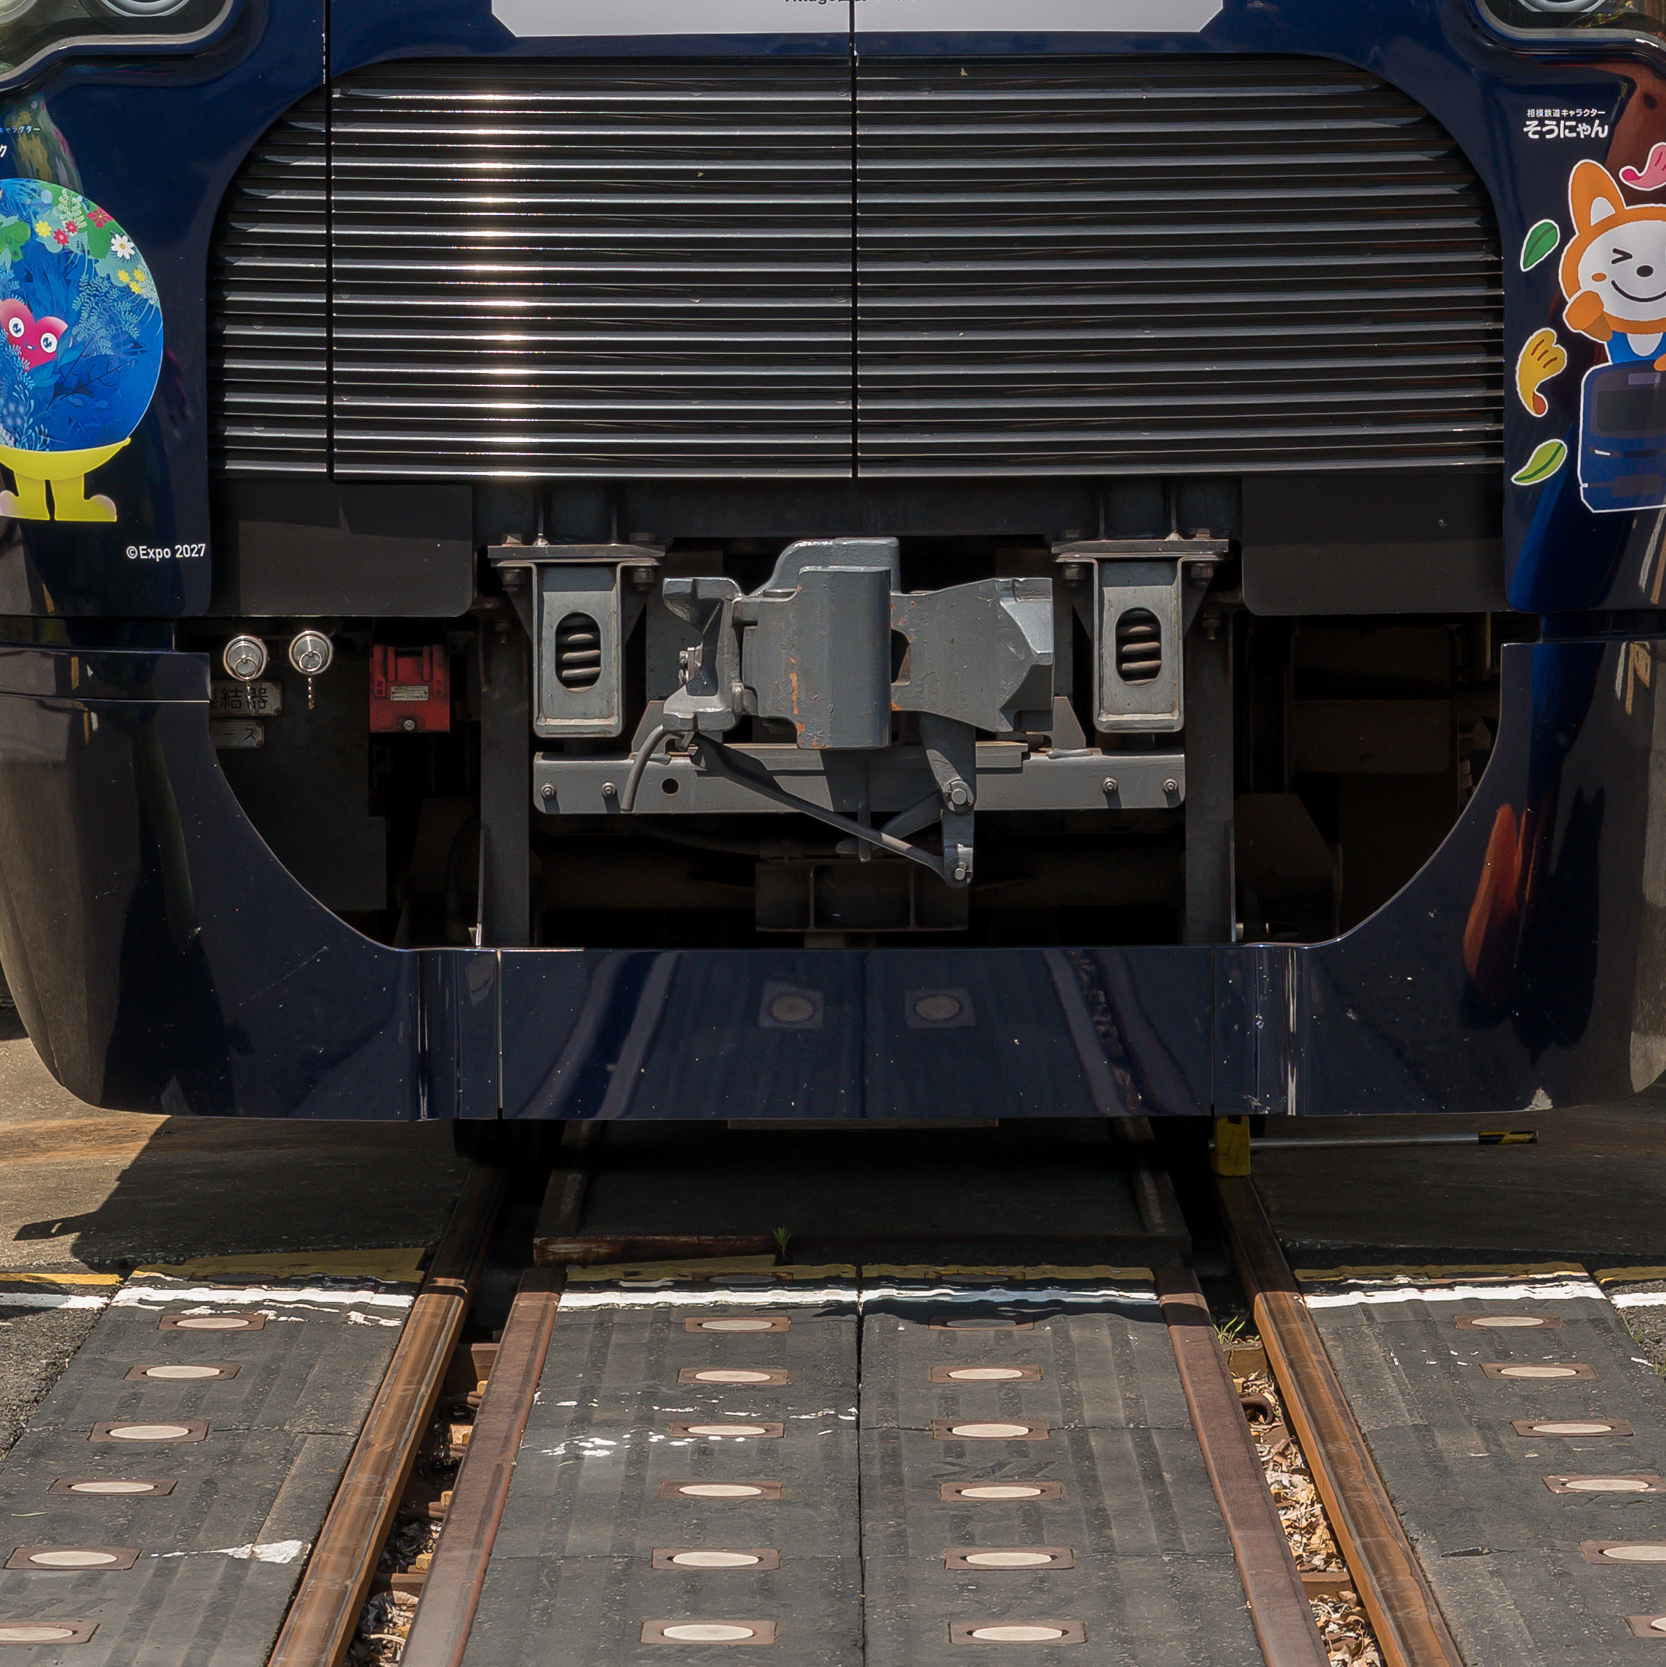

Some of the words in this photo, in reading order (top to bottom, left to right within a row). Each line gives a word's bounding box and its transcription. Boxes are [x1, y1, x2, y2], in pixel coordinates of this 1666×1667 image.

[1526, 108, 1606, 118] 相模鉄道キャラクター
[1523, 119, 1609, 139] そうにゃん
[175, 543, 207, 559] 2027
